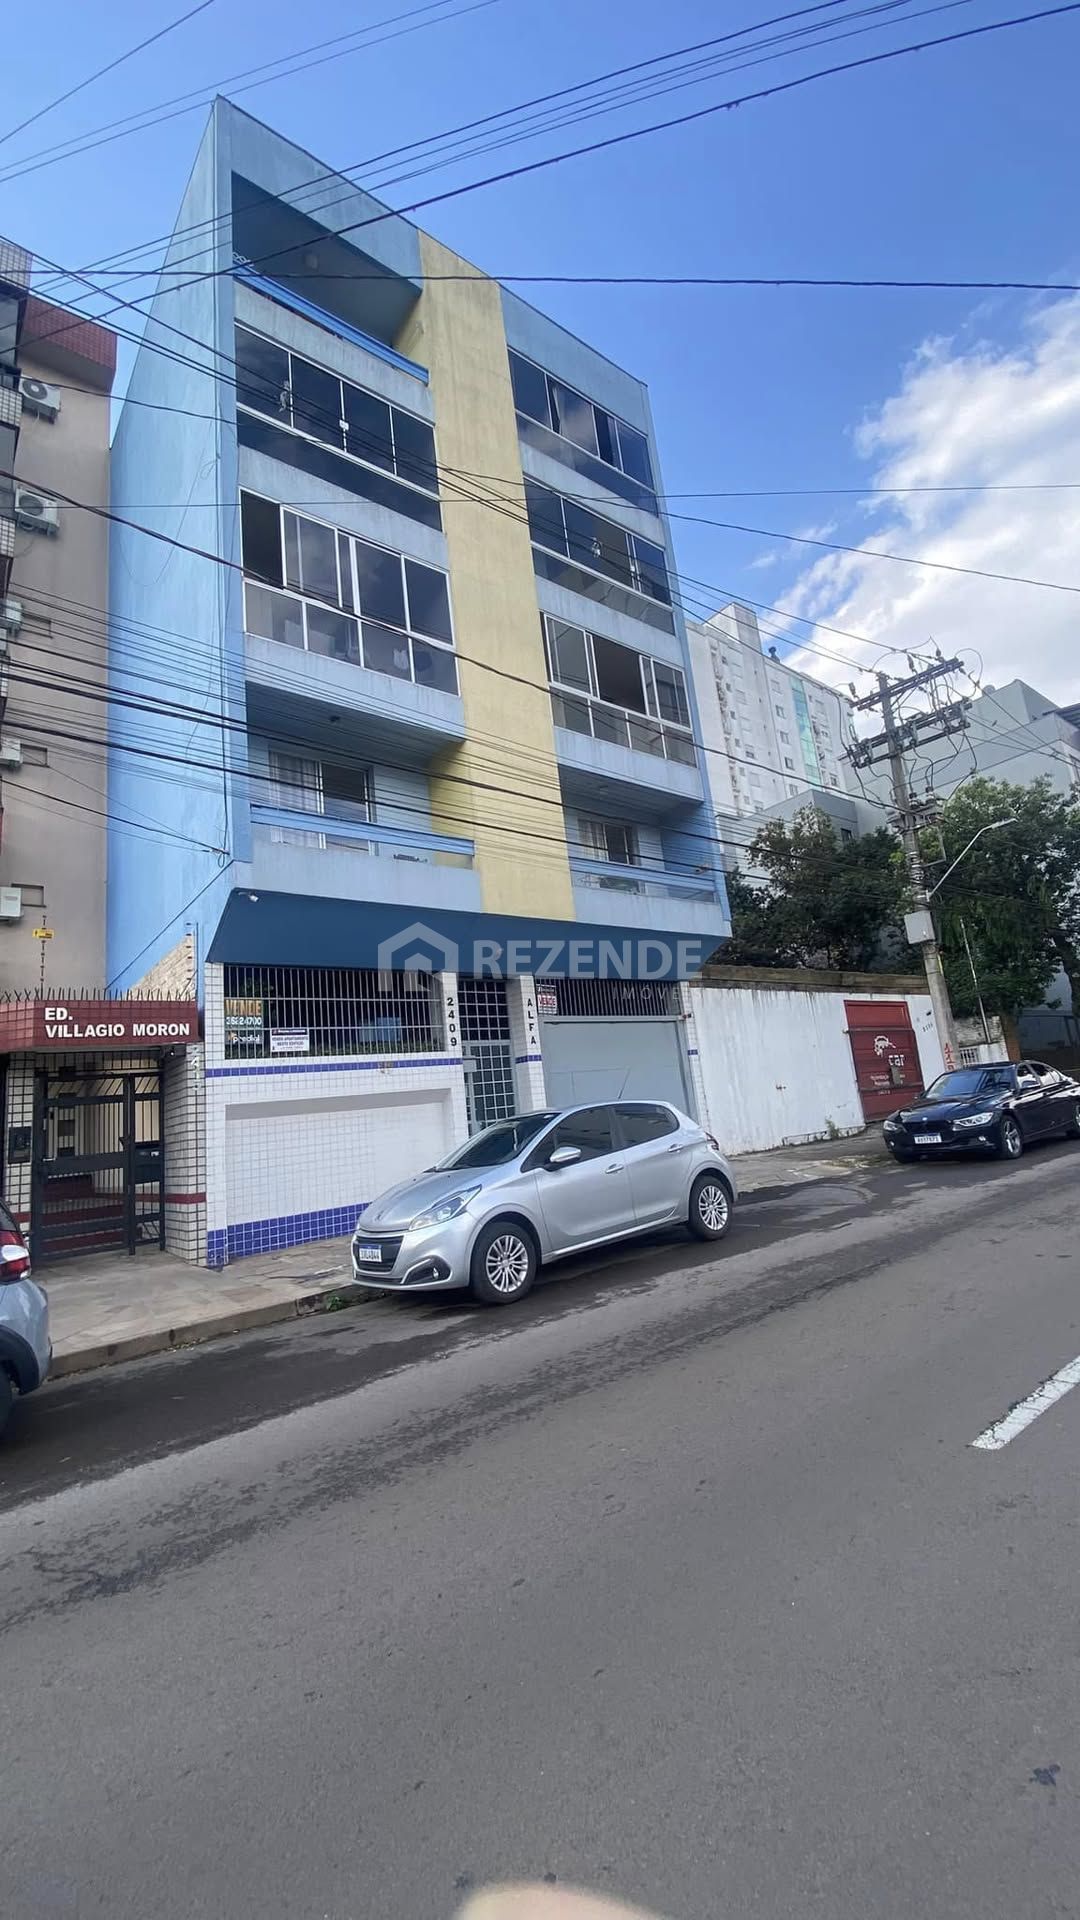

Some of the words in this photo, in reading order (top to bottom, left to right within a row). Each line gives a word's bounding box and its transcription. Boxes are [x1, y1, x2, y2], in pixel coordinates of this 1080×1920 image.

[44, 1007, 73, 1021] ED.
[226, 1000, 262, 1016] VENDE
[447, 997, 457, 1046] 2409
[527, 998, 537, 1044] ALFA
[45, 1024, 125, 1038] VILLAGIO
[133, 1023, 190, 1037] MORON
